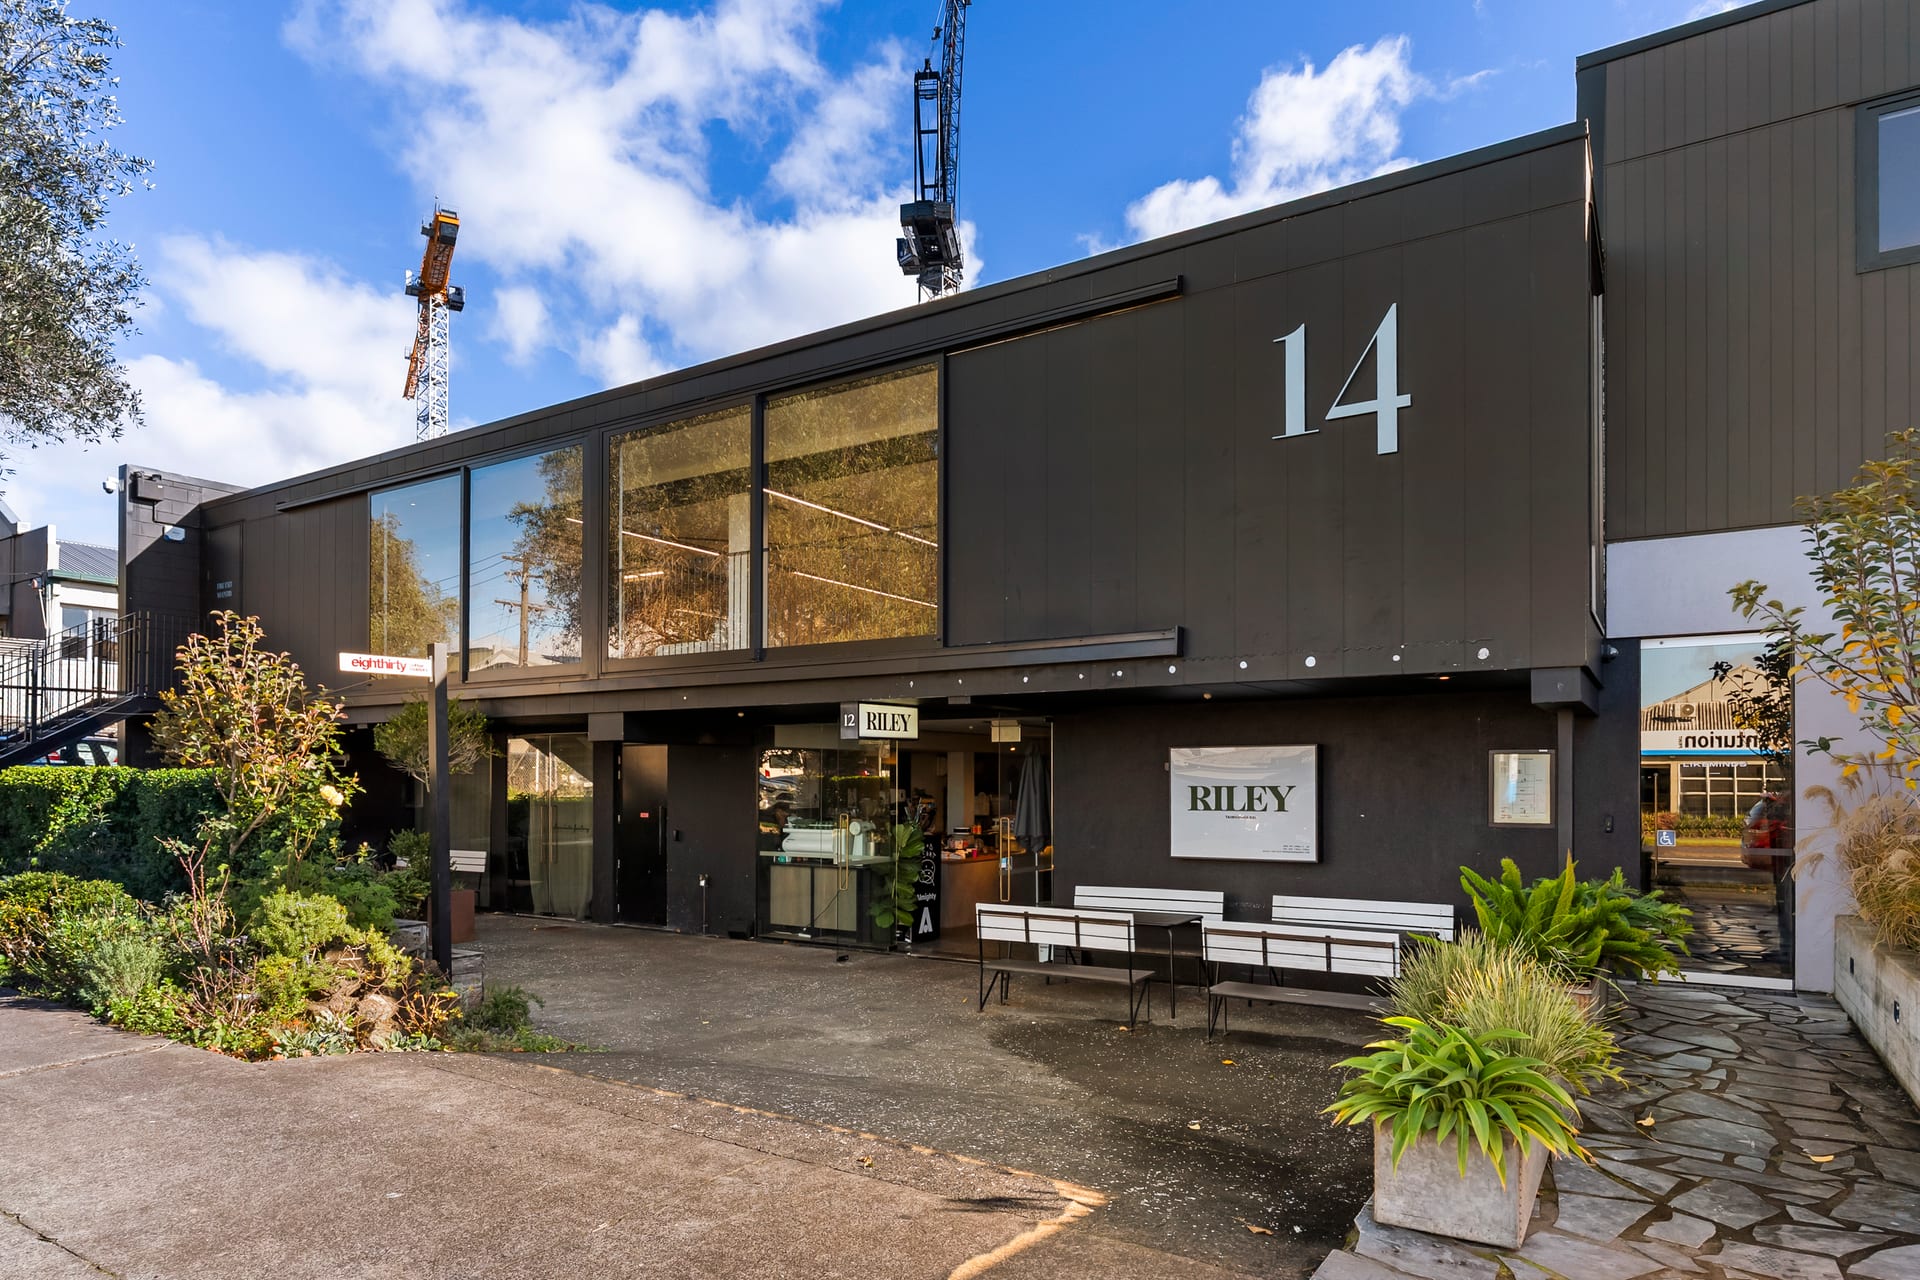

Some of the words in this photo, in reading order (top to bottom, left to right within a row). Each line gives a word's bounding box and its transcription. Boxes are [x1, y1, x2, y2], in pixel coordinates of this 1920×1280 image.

[1271, 302, 1412, 455] 14
[352, 656, 407, 671] eighthirty
[844, 713, 855, 727] 12
[866, 711, 911, 732] RILEY
[1187, 785, 1296, 812] RILEY
